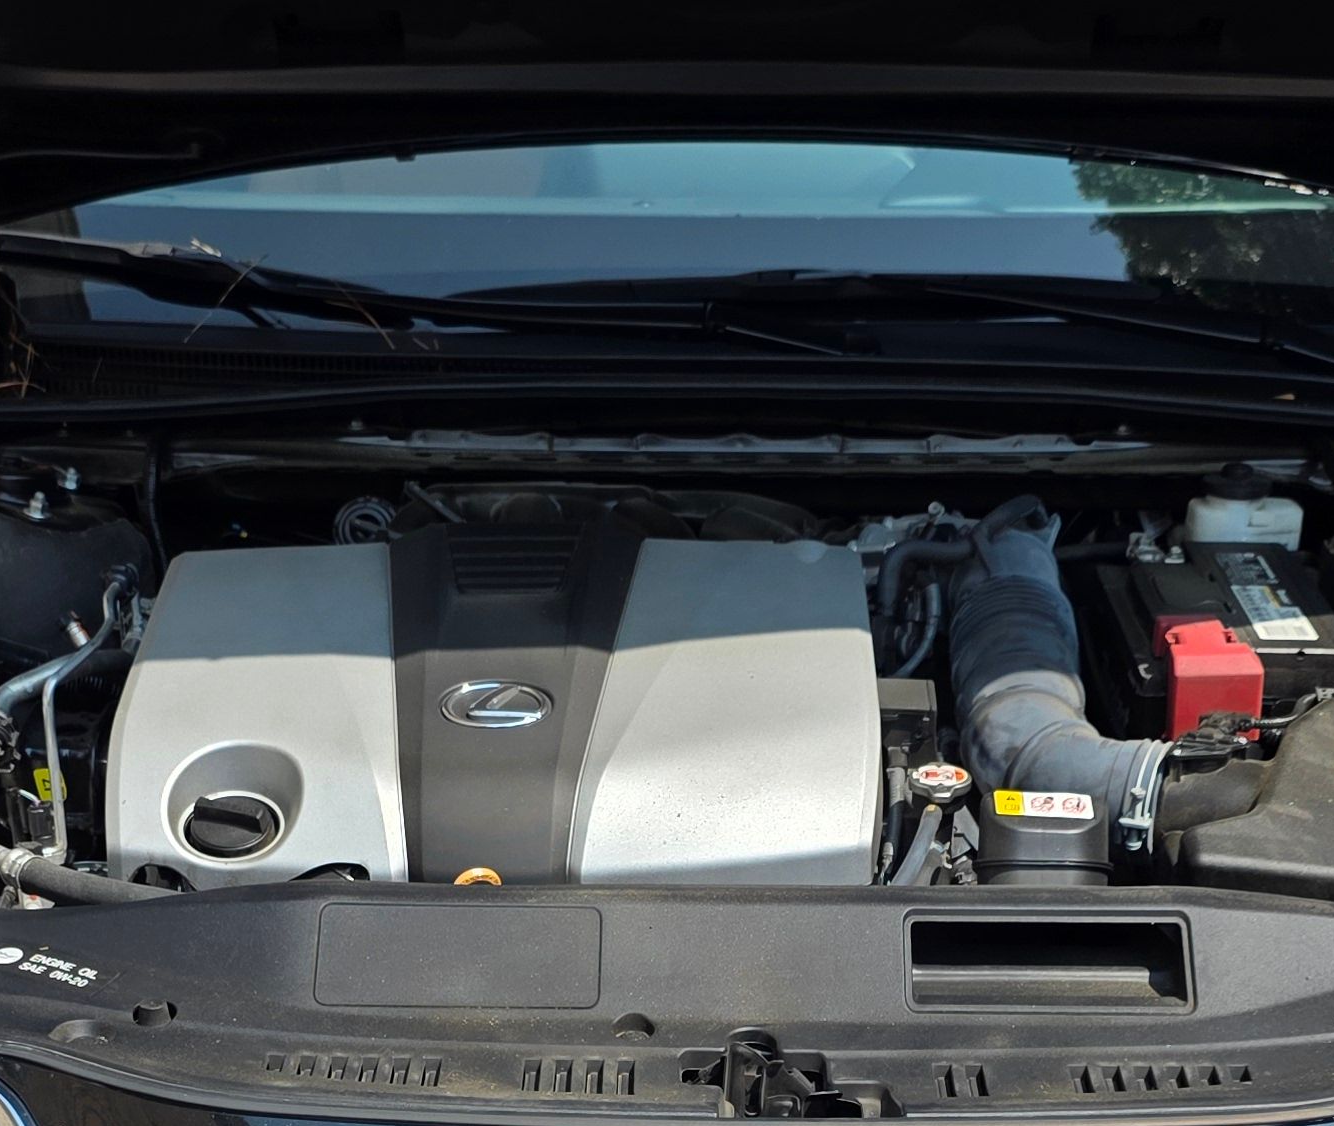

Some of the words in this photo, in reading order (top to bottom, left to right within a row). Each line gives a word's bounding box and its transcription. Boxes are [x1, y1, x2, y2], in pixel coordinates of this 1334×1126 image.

[18, 962, 47, 975] SAE
[49, 970, 89, 987] 0W-20
[29, 953, 77, 972] ENGINE
[78, 967, 98, 980] OIL
